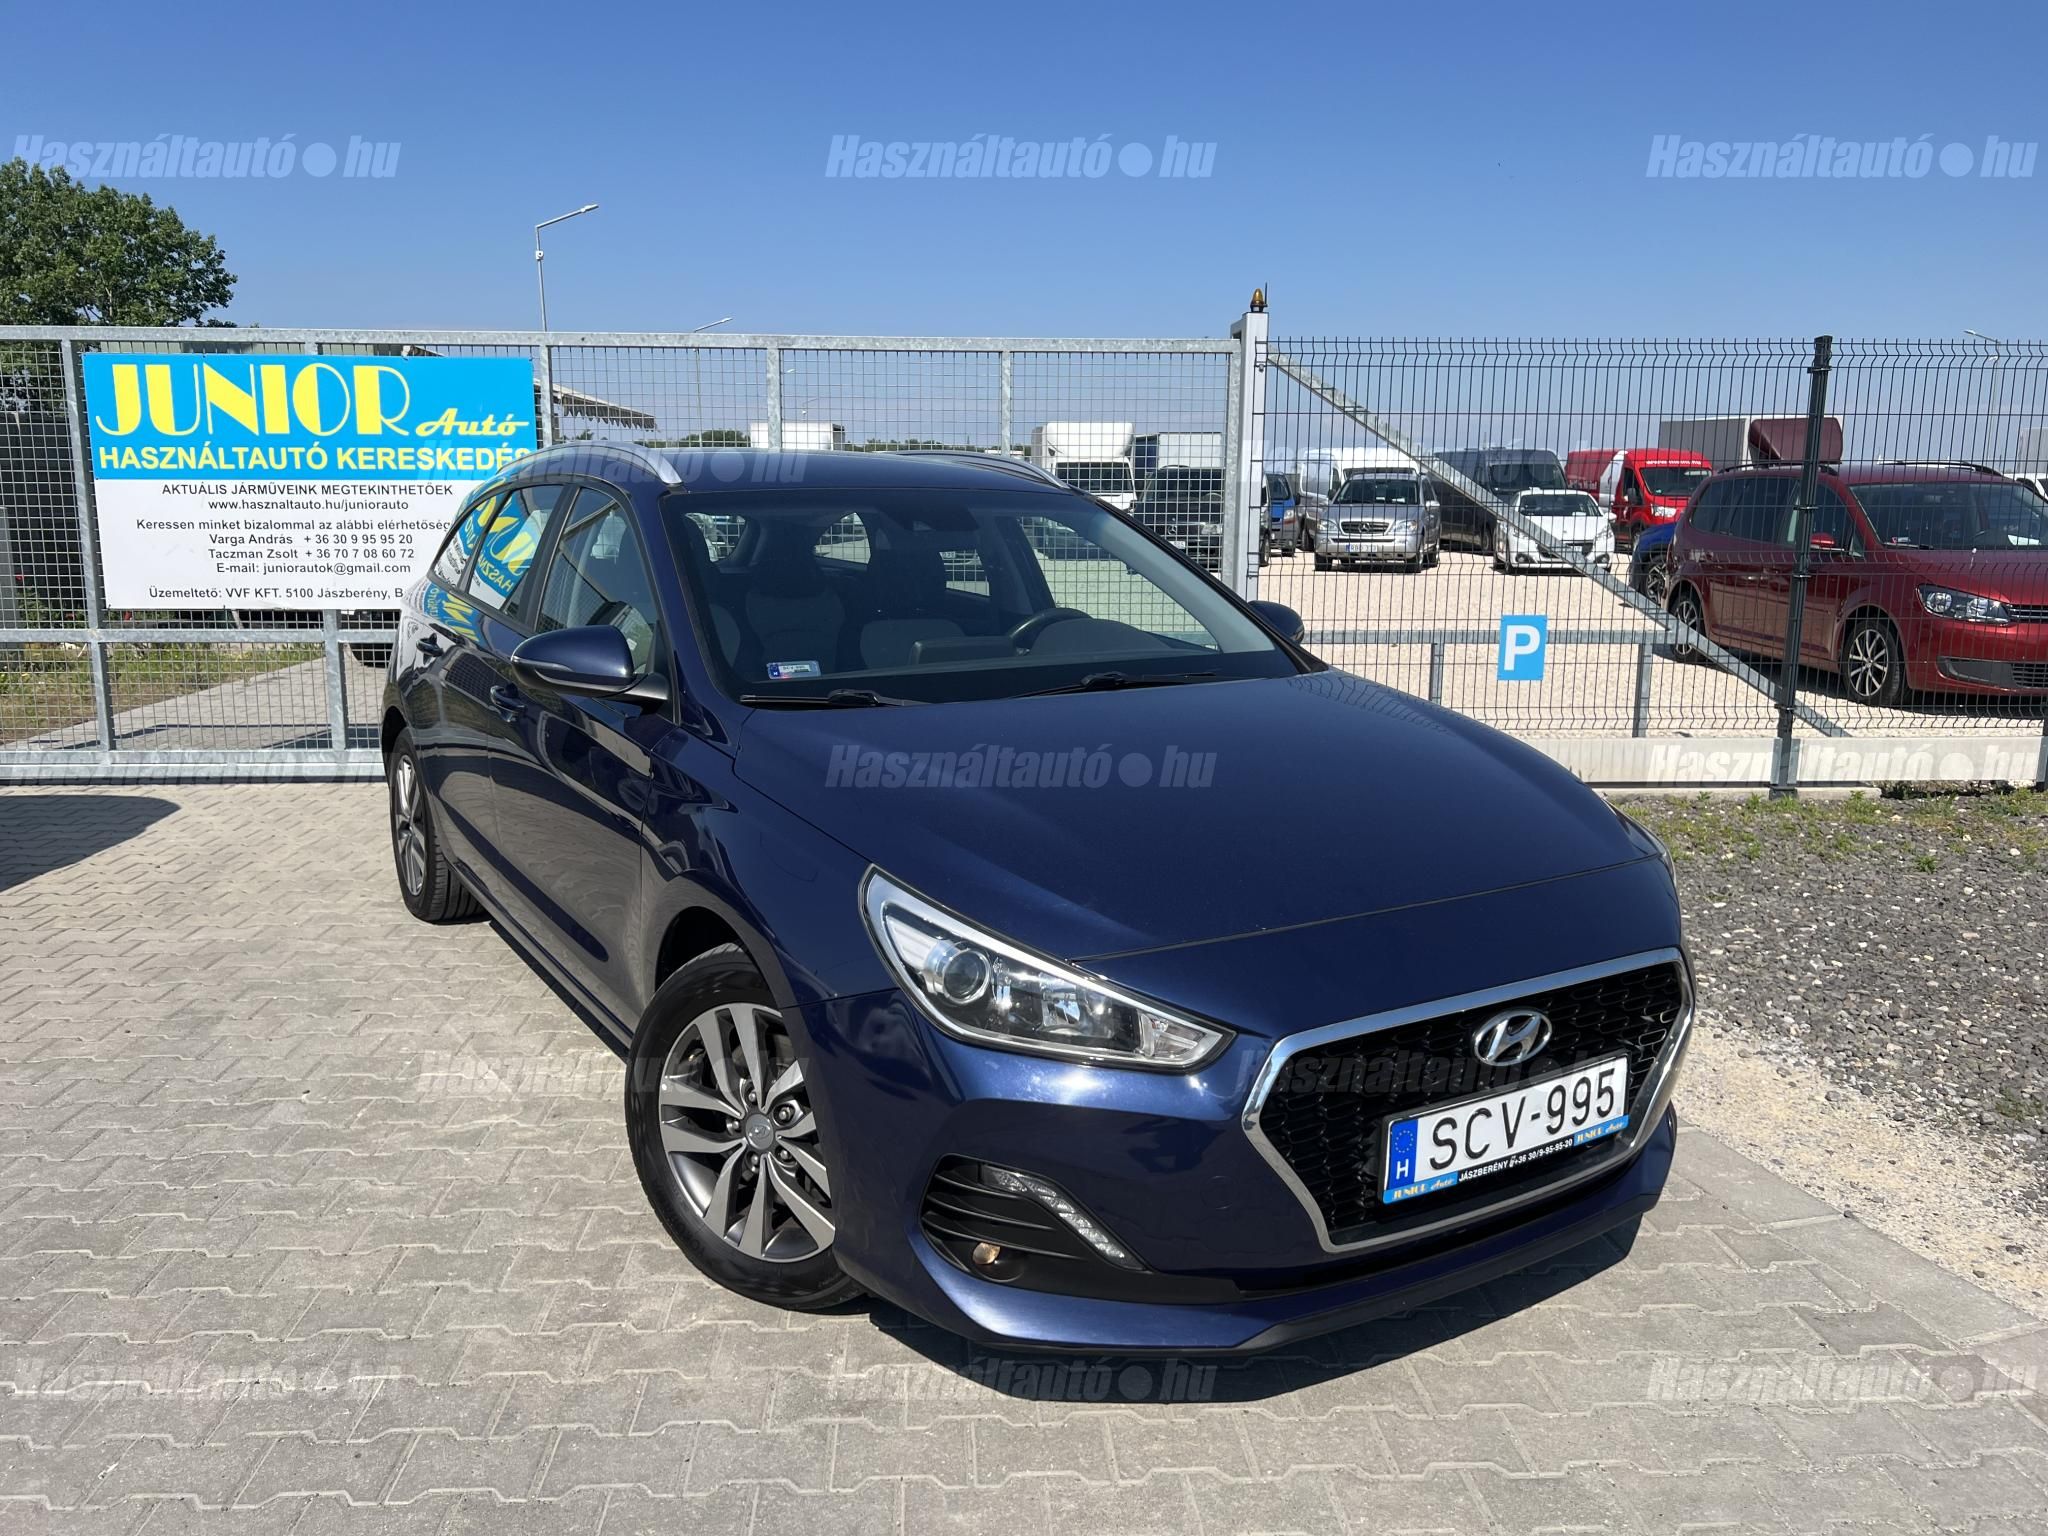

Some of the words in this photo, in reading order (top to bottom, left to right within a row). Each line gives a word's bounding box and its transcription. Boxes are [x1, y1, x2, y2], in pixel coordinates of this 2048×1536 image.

[95, 362, 410, 437] JUNIOR
[415, 408, 530, 437] Autó
[100, 441, 328, 470] HASZNÁLTAUTÓ
[162, 481, 227, 495] AKTUÁLIS
[231, 481, 317, 495] JÁRMŰVEINK
[321, 481, 453, 495] MEGTEKINTHETŐEK
[208, 499, 409, 512] www.hasznaltauto.hu/juniorauto
[136, 519, 195, 530] Keressen
[199, 519, 241, 530] minket
[244, 519, 315, 531] bizalommal
[319, 522, 332, 530] az
[336, 519, 374, 531] alábbi
[209, 534, 245, 547] Varga
[249, 534, 293, 544] András
[315, 534, 329, 544] 36
[333, 534, 347, 544] 30
[350, 534, 358, 544] 9
[362, 534, 376, 544] 95
[380, 534, 395, 544] 95
[399, 534, 413, 544] 20
[208, 549, 263, 559] Taczman
[266, 549, 298, 559] Zsolt
[316, 549, 330, 559] 36
[334, 549, 348, 559] 70
[352, 549, 359, 559] 7
[363, 549, 377, 559] 08
[382, 549, 396, 559] 60
[400, 549, 415, 559] 72
[216, 563, 259, 573] E-mail:
[262, 563, 411, 576] juniorautok@gmail.com
[149, 585, 222, 598] Üzemeltető:
[225, 588, 251, 598] VVF
[254, 588, 282, 598] KFT.
[285, 588, 314, 598] 5100
[317, 587, 391, 601] Jászberény,
[1503, 624, 1541, 672] P
[1429, 1068, 1616, 1170] SCV-995
[1396, 1159, 1409, 1180] H
[1458, 1159, 1509, 1182] JÁSZBERÉNY
